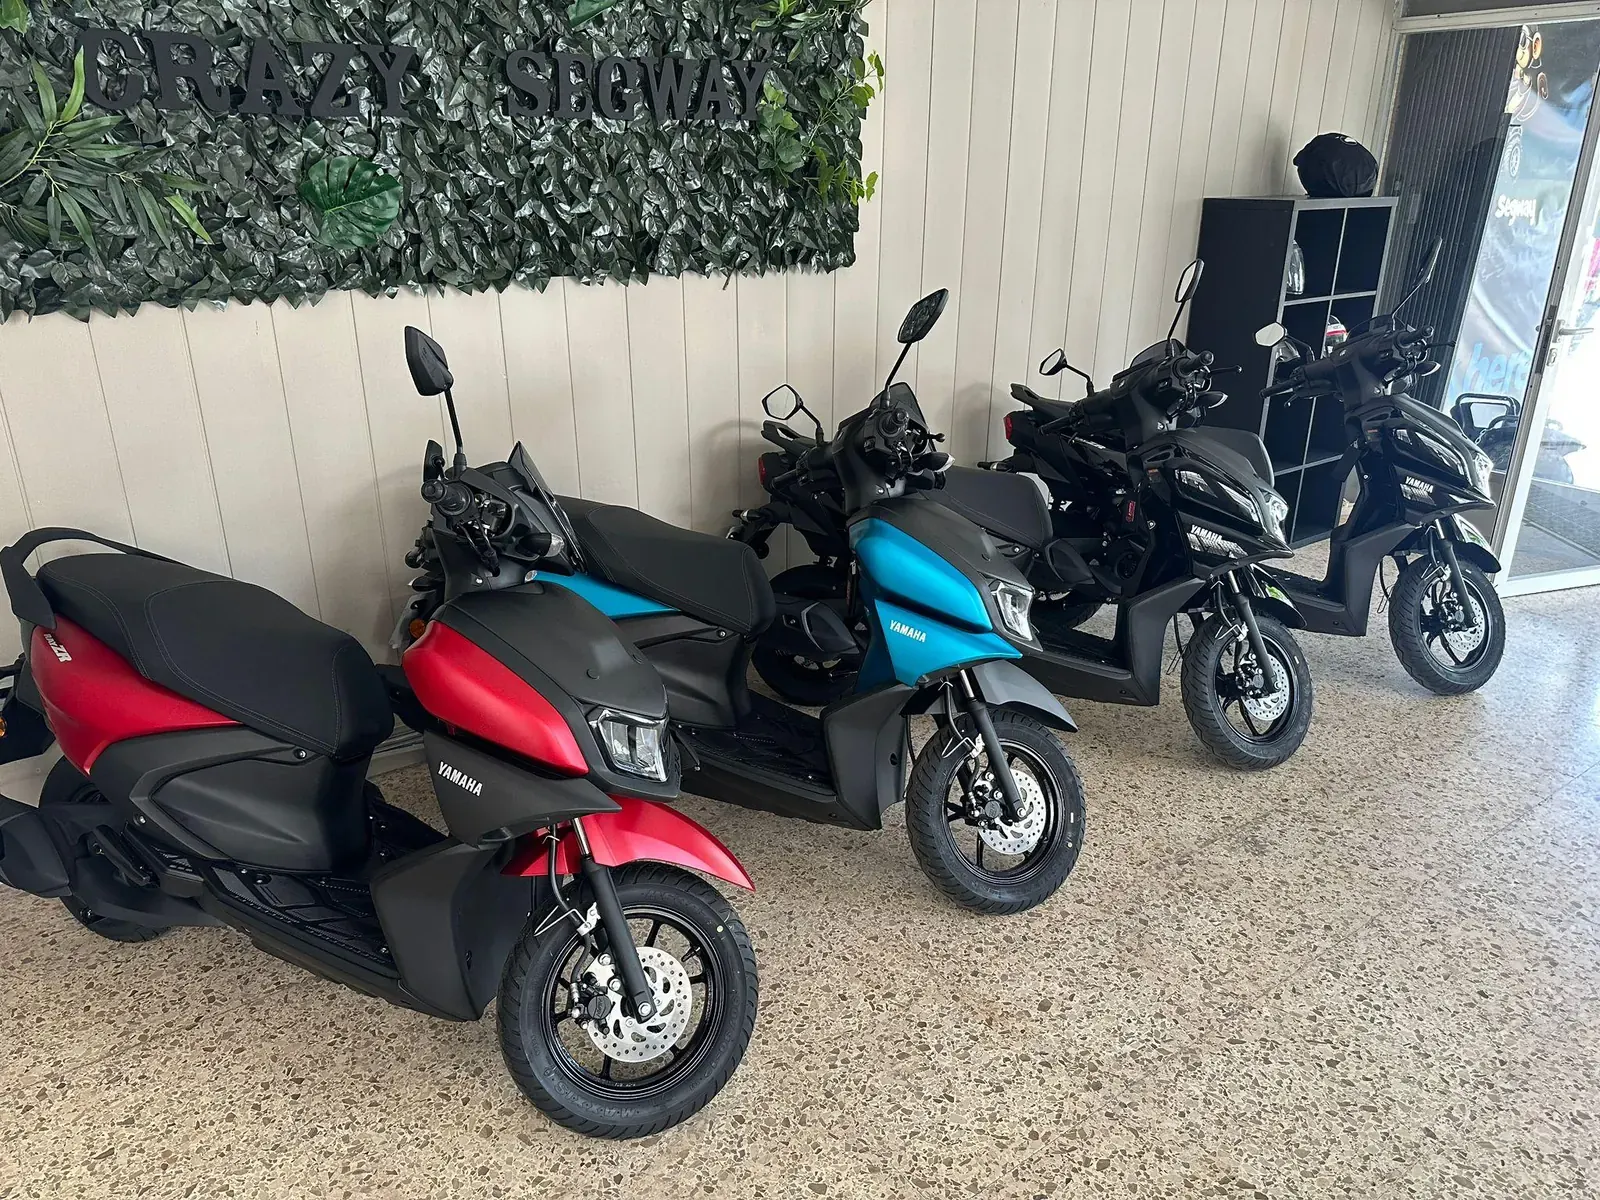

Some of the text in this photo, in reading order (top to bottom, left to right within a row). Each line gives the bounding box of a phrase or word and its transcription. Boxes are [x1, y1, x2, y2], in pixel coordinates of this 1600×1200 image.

[80, 28, 772, 122] CRAZY SEGWAY
[1405, 475, 1434, 493] YAMAHA
[1190, 524, 1223, 542] YAMAHA
[890, 619, 927, 643] YAMAHA
[437, 760, 483, 797] YAMAHA
